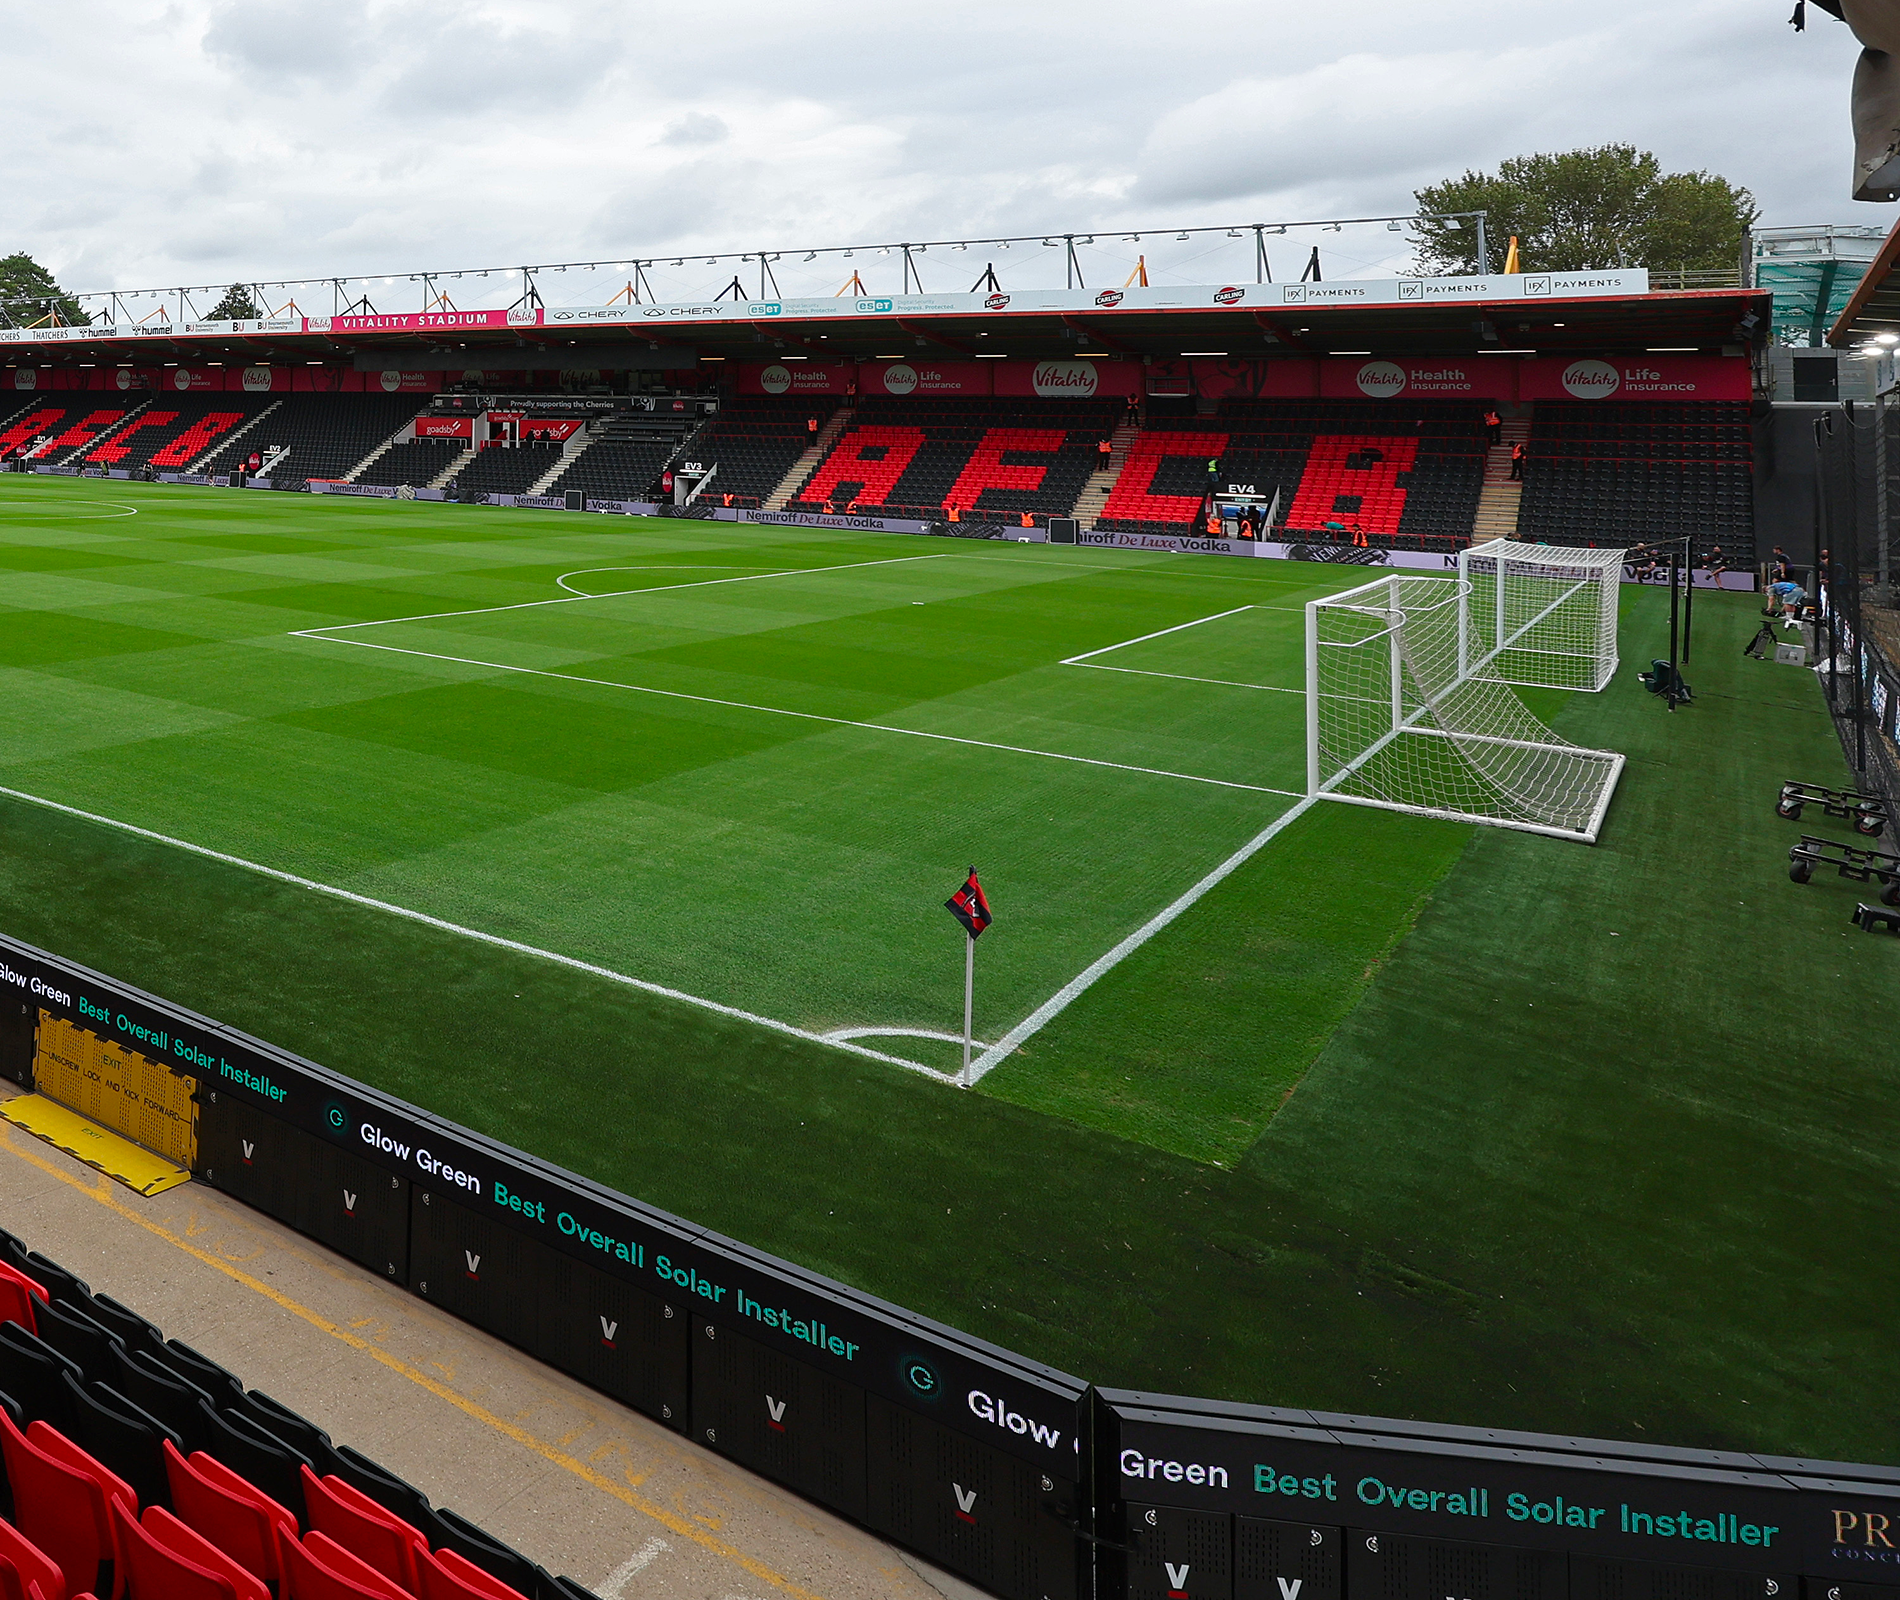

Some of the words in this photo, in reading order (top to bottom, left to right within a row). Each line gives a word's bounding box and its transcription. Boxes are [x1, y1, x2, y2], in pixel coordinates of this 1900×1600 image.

[1426, 284, 1488, 293] PAYMENTS
[1555, 278, 1622, 289] PAYMENTS
[1096, 293, 1123, 304] CARLING
[1215, 290, 1244, 302] CARLING
[1308, 288, 1366, 297] PAYMENTS
[986, 296, 1009, 307] CARLING
[507, 308, 537, 325] Vitality
[578, 309, 627, 320] CHERY
[670, 306, 724, 316] CHERY
[232, 321, 245, 332] BU
[257, 321, 267, 330] BU
[308, 317, 331, 330] Vitality
[342, 315, 409, 328] VITALITY
[418, 313, 488, 326] STADIUM
[32, 329, 69, 340] THATCHERS
[88, 327, 117, 338] hummel
[142, 325, 173, 336] hummel
[185, 324, 195, 333] BU
[243, 370, 271, 388] Vitality
[402, 373, 425, 381] Health
[761, 372, 792, 388] Vitality
[793, 372, 827, 381] Health
[884, 371, 918, 388] Vitality
[920, 371, 942, 381] Life
[1034, 364, 1098, 391] Vitality
[1357, 371, 1406, 389] Vitality
[1411, 369, 1466, 381] Health
[1563, 369, 1619, 391] Vitality
[1625, 368, 1661, 381] Life
[793, 380, 830, 388] insurance
[920, 381, 962, 389] insurance
[1411, 381, 1472, 390] insurance
[1625, 381, 1696, 392] insurance
[536, 400, 572, 409] supporting
[573, 400, 585, 408] the
[586, 400, 615, 408] Cherries
[426, 423, 455, 436] goadsby
[684, 462, 702, 470] EV3
[177, 474, 205, 483] Nemiroff
[329, 483, 362, 494] Nemiroff
[373, 487, 392, 496] Luxe
[1228, 484, 1256, 494] EV4
[513, 495, 554, 507] Nemiroff
[591, 500, 623, 512] Vodka
[745, 510, 797, 524] Nemiroff
[799, 514, 814, 525] De
[816, 515, 844, 527] Luxe
[845, 517, 884, 529] Vodka
[1118, 533, 1138, 546] De
[1140, 535, 1177, 549] Luxe
[1179, 537, 1231, 553] Vodka
[29, 975, 71, 1008] Green
[78, 994, 111, 1025] Best
[116, 1011, 168, 1051] Overall
[173, 1036, 216, 1073] Solar
[219, 1056, 288, 1104] Installer
[102, 1053, 122, 1071] EXIT
[48, 1051, 80, 1073] UNSCREW
[82, 1066, 101, 1083] LOCK
[105, 1078, 120, 1093] AND
[123, 1085, 140, 1103] KICK
[143, 1096, 180, 1123] FORWARD
[80, 1127, 104, 1140] EXIT
[359, 1122, 410, 1162] Glow
[415, 1147, 481, 1196] Green
[493, 1179, 547, 1225] Best
[556, 1210, 645, 1271] Overall
[654, 1254, 727, 1307] Solar
[736, 1288, 861, 1364] Installer
[967, 1388, 1062, 1451] Glow
[1120, 1447, 1229, 1490] Green
[1252, 1463, 1338, 1503] Best
[1356, 1475, 1490, 1520] Overall
[1505, 1492, 1607, 1533] Solar
[1620, 1502, 1780, 1548] Installer
[1831, 1508, 1900, 1549] PR
